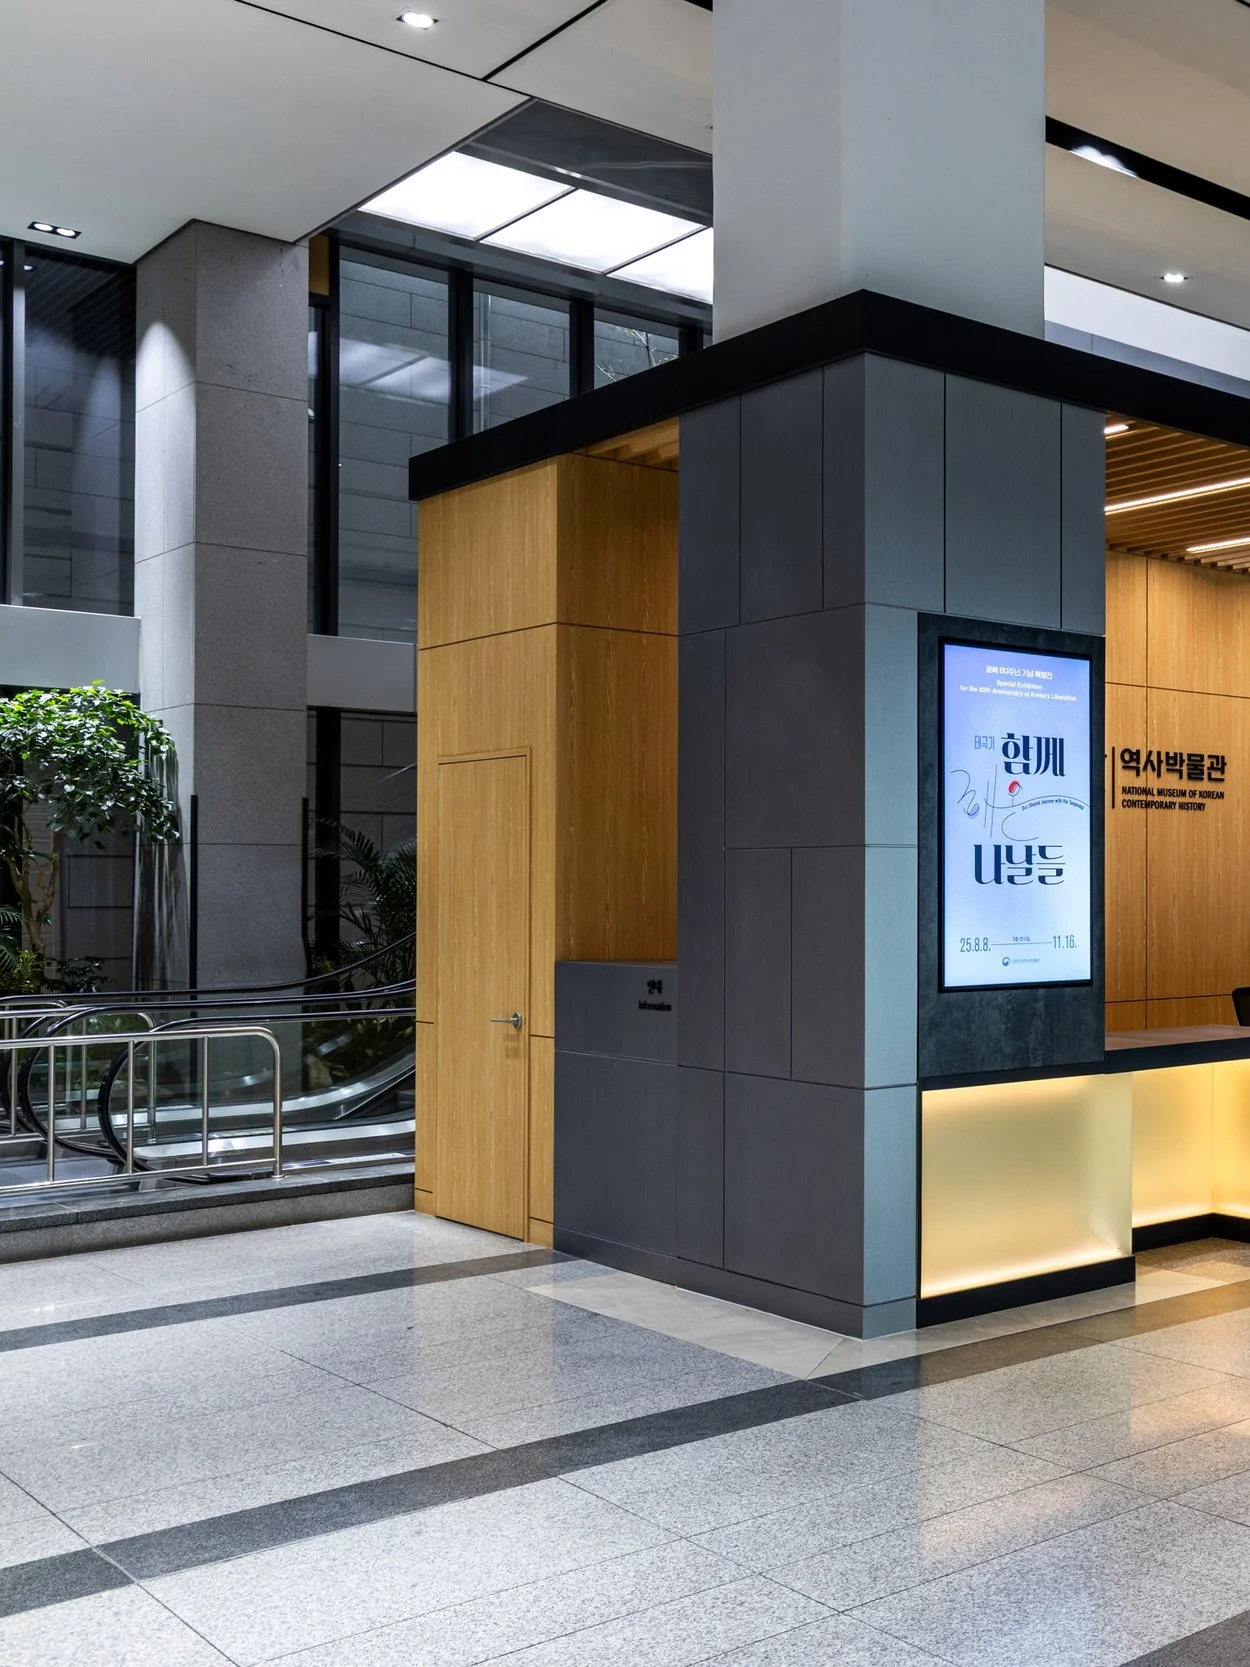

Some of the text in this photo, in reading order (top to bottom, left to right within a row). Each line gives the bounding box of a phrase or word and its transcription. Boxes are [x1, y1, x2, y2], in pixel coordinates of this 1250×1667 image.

[959, 684, 968, 692] for
[968, 685, 978, 693] the
[992, 688, 1023, 698] Anniversary
[1051, 693, 1077, 702] Liberation
[996, 679, 1043, 690] Special Exhibition
[974, 732, 1066, 777] 태극기 함께
[1120, 747, 1228, 782] 역사박물관
[1121, 786, 1225, 800] NATIONAL MUSEUM OF KOREAN
[1121, 799, 1206, 812] CONTEMPORARY HISTORY
[973, 843, 1066, 886] 나날들
[960, 936, 992, 953] 25.8.8.
[1052, 934, 1077, 949] 11.16.
